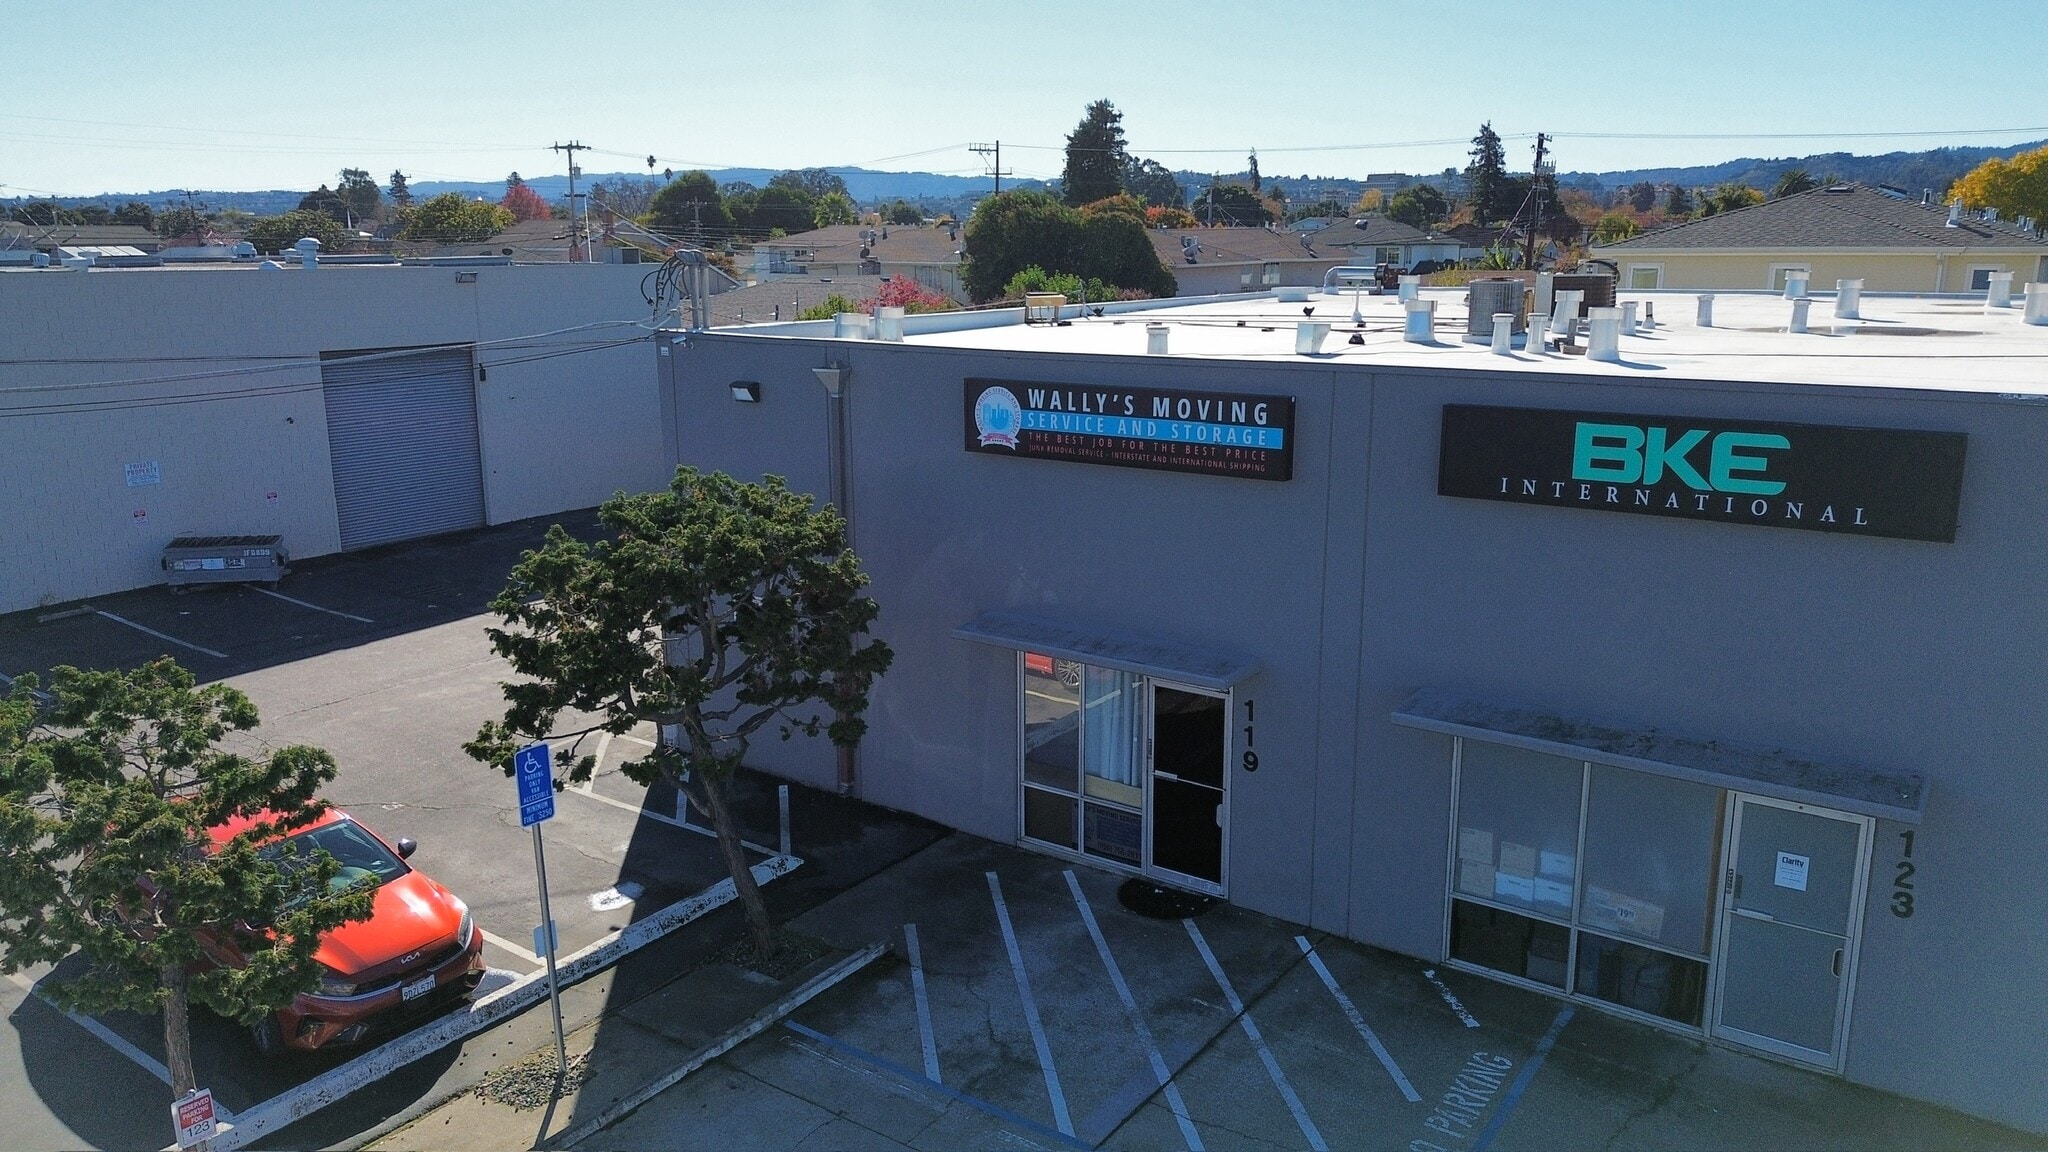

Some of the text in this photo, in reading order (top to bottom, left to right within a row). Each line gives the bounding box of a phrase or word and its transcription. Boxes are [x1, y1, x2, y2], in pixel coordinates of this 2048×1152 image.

[1028, 388, 1267, 426] WALLY'S MOVING
[1027, 412, 1266, 447] SERVICE AND STORAGE
[1028, 431, 1266, 461] THE BEST JOB FOR THE BEST PRICE
[129, 461, 153, 470] PRIVATE
[1028, 443, 1044, 453] JUNK
[1046, 445, 1076, 456] REMOVAL
[1078, 448, 1104, 458] SERVICE
[1111, 451, 1150, 463] INTERSTATE
[1152, 455, 1168, 464] AND
[1169, 457, 1227, 470] INTERNATIONAL
[1229, 462, 1266, 473] SHIPPING
[1571, 420, 1792, 496] BKE
[127, 467, 157, 477] PROPERTY
[1501, 476, 1868, 526] INTERNATIONAL
[1243, 699, 1259, 773] 119
[524, 770, 545, 782] PARKING
[528, 778, 541, 788] ONLY
[523, 789, 550, 804] ACCESSIBLE
[531, 786, 541, 795] VAN
[523, 807, 553, 825] FINE $250
[526, 800, 549, 815] MINIMUM
[1781, 856, 1805, 868] Clarity
[1890, 830, 1916, 919] 123
[1424, 1051, 1513, 1138] PARKING
[180, 1097, 209, 1114] RESERVED
[182, 1104, 209, 1120] PARKING
[191, 1114, 204, 1124] FOR
[187, 1120, 210, 1137] 123
